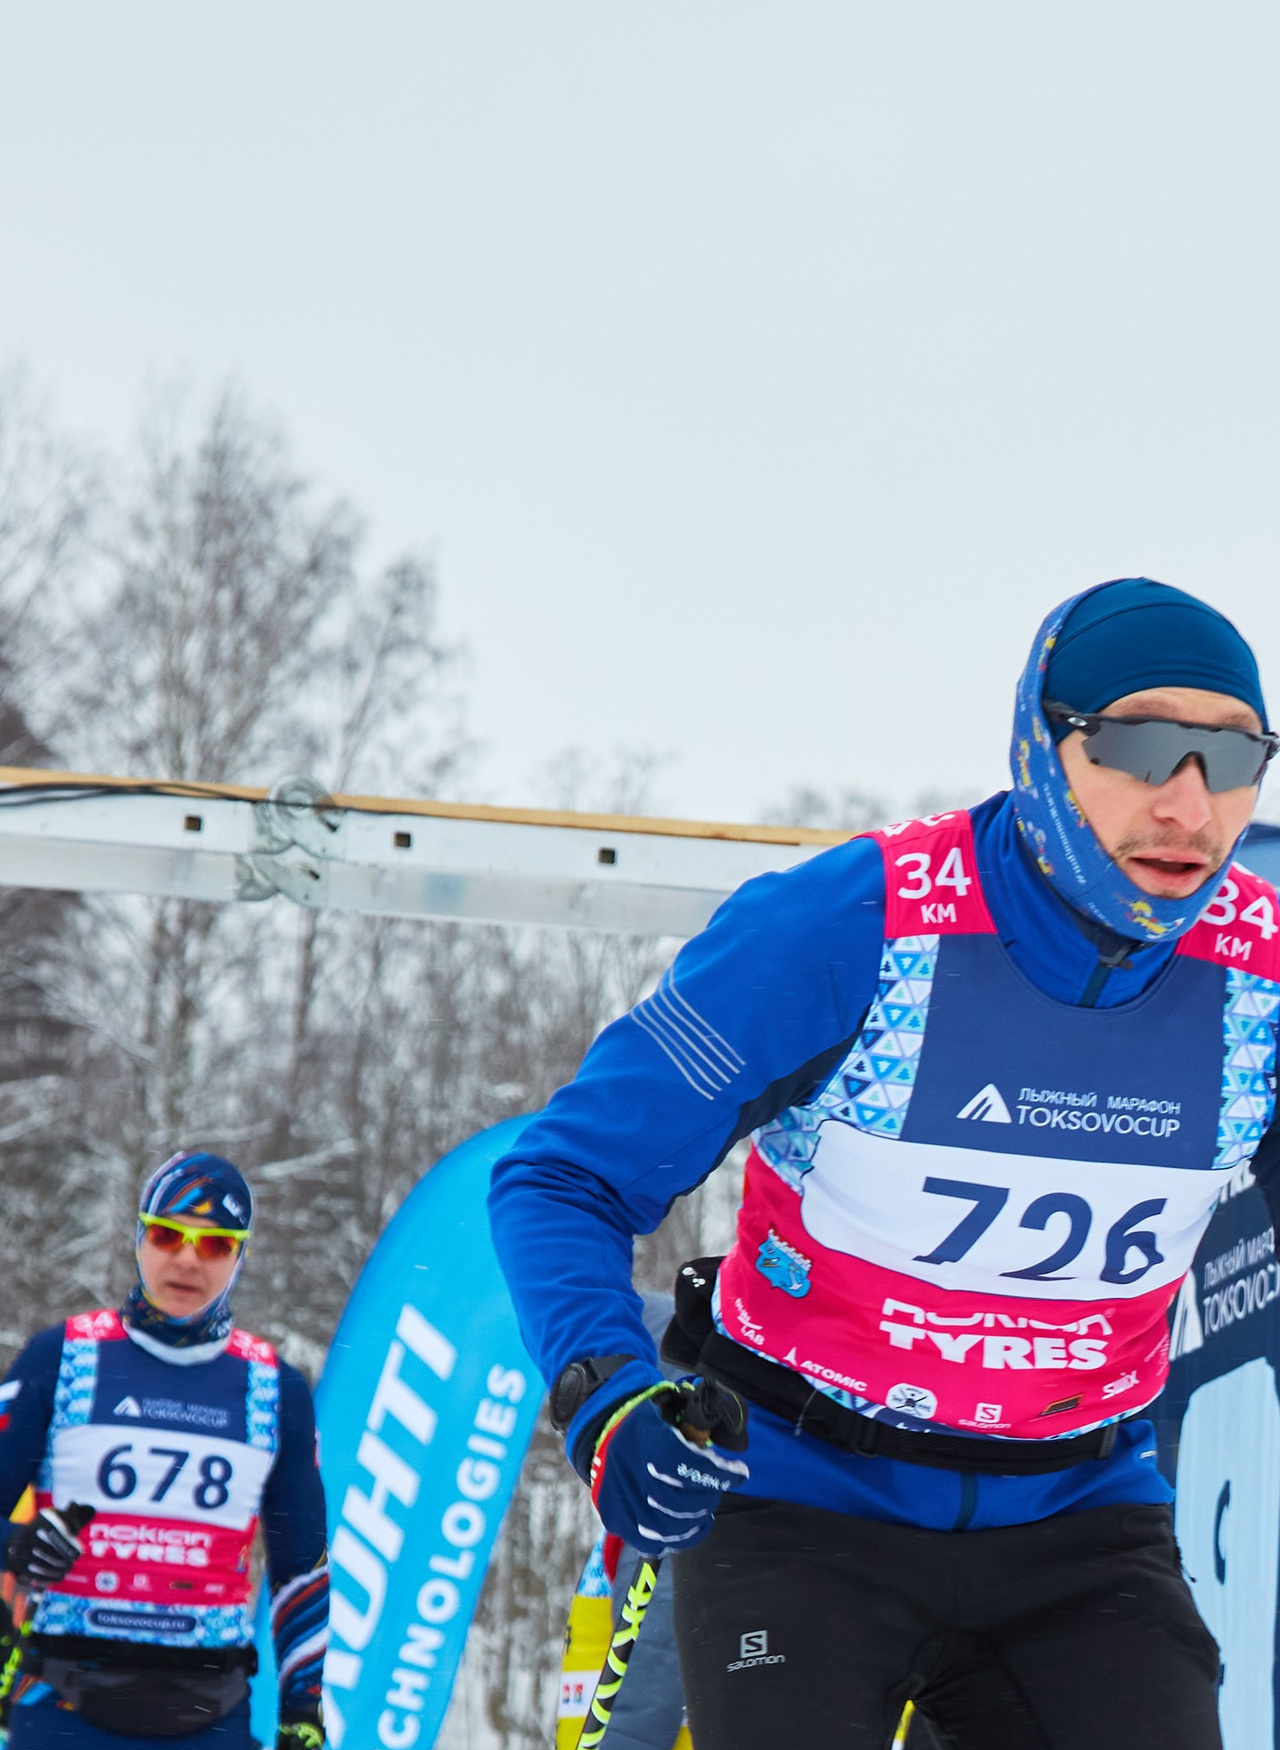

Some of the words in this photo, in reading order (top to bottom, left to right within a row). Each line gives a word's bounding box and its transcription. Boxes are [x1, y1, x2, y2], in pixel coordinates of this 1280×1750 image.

[894, 847, 973, 900] 34
[920, 902, 958, 924] KM
[1200, 878, 1280, 941] 34
[1214, 932, 1253, 962] KM
[1018, 1086, 1097, 1108] ЛЫЖНЫЙ
[1106, 1092, 1181, 1115] МАРАФОН
[1016, 1104, 1181, 1138] TOKSOVOCUP
[912, 1176, 1168, 1285] 726
[880, 1321, 1109, 1370] TYRES
[800, 1359, 868, 1392] ATOMIC
[96, 1443, 234, 1510] 678
[89, 1540, 210, 1568] TYRES
[727, 1654, 786, 1672] salomon
